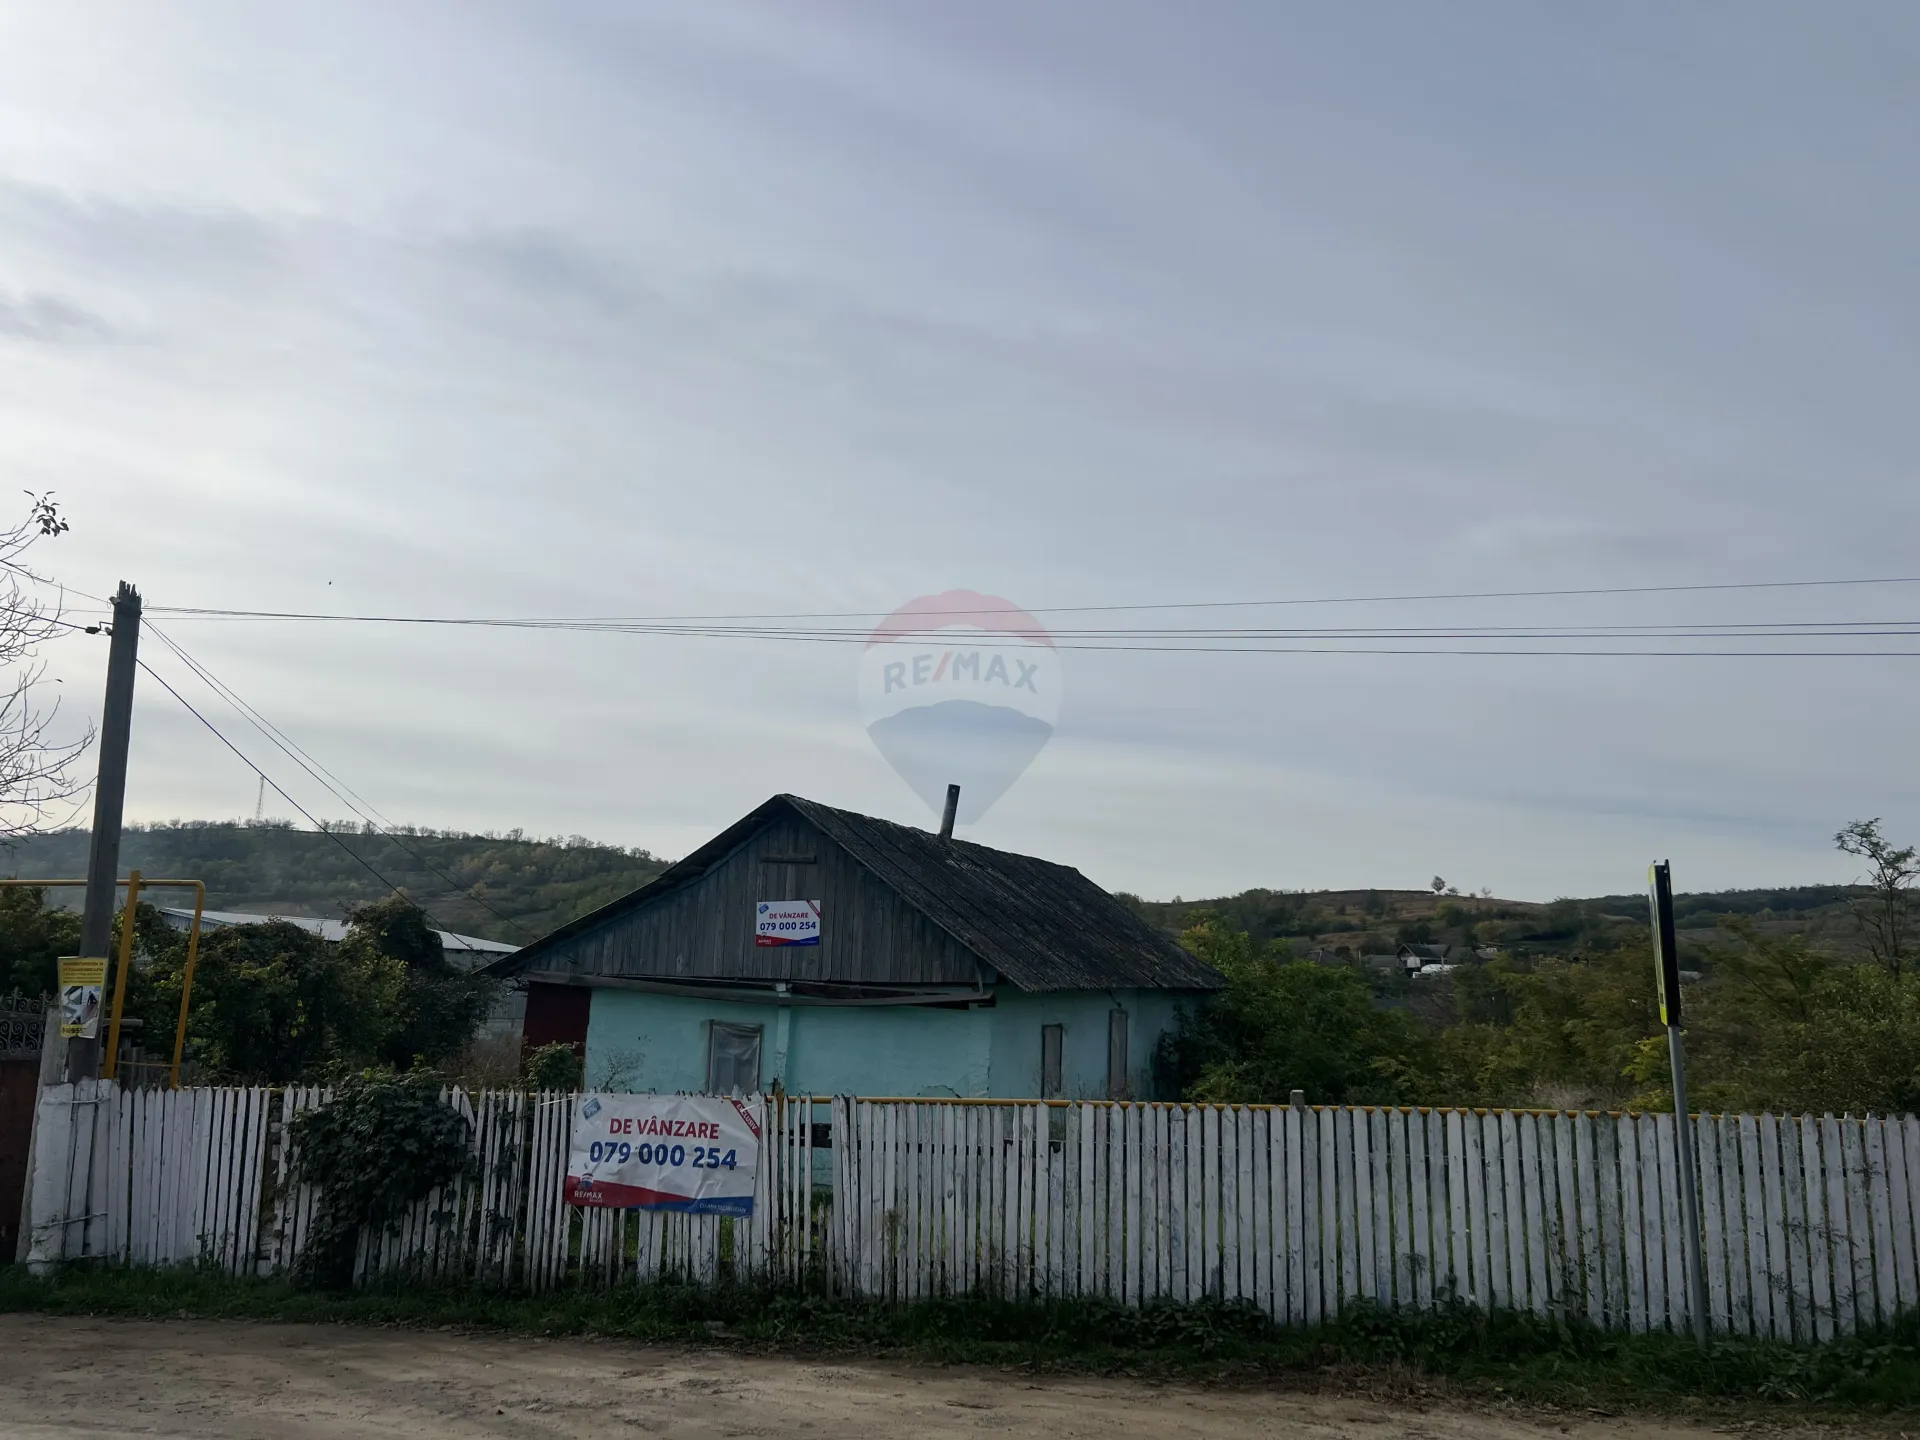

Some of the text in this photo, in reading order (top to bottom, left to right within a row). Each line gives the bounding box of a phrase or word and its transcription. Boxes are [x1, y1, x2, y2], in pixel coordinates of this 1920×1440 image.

[760, 921, 816, 931] 079 000 254
[609, 1116, 720, 1139] DE VÂNZARE
[589, 1141, 738, 1171] 079 000 254
[574, 1190, 603, 1200] RE/MAX
